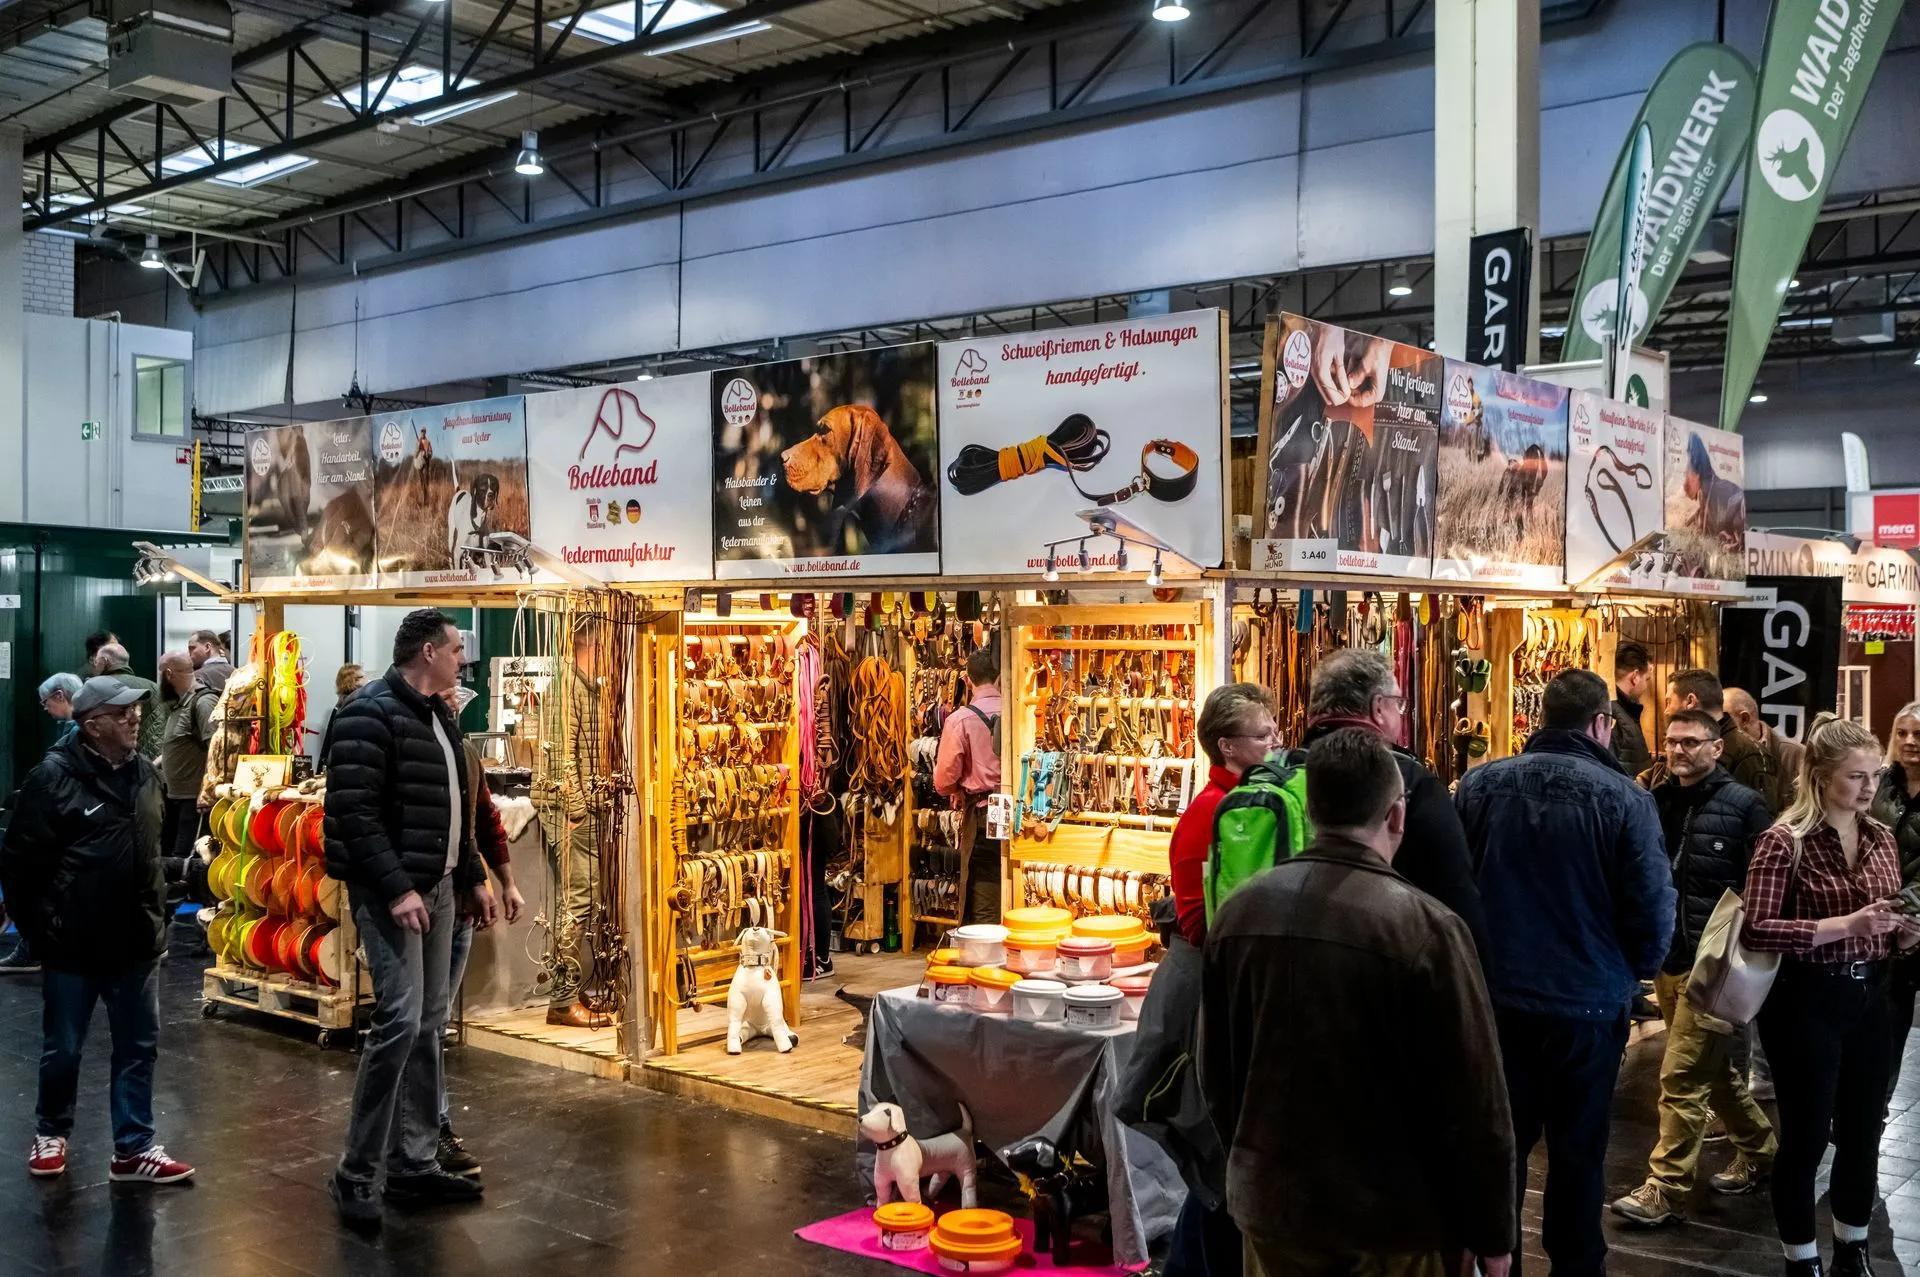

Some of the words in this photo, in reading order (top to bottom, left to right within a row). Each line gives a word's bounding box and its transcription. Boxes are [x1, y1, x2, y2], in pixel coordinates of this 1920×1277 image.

[1823, 81, 1846, 120] Der
[1650, 245, 1674, 277] Der
[1668, 157, 1718, 245] Jagdhelfer
[1483, 247, 1512, 370] GAR
[1001, 337, 1101, 361] Schweißriemen
[1105, 331, 1116, 349] &
[1120, 326, 1199, 347] Halsungen
[951, 375, 990, 387] Bolleband
[1390, 367, 1404, 387] Wir
[1404, 372, 1435, 398] fertigen
[724, 402, 756, 413] Bolleband
[1397, 402, 1413, 420] hier
[333, 432, 351, 446] Leder.
[474, 431, 491, 445] Leder
[321, 450, 361, 464] Handarbeit.
[316, 471, 330, 484] Hier
[331, 474, 343, 483] am
[344, 469, 366, 482] Stand.
[568, 459, 658, 490] Bolleband
[725, 475, 769, 489] Halsbänder
[770, 473, 778, 486] &
[739, 496, 762, 510] Leinen
[738, 518, 752, 527] aus
[753, 515, 765, 526] der
[1266, 552, 1282, 562] JAGD
[1301, 551, 1326, 560] 3.A40
[1264, 560, 1283, 570] HUND
